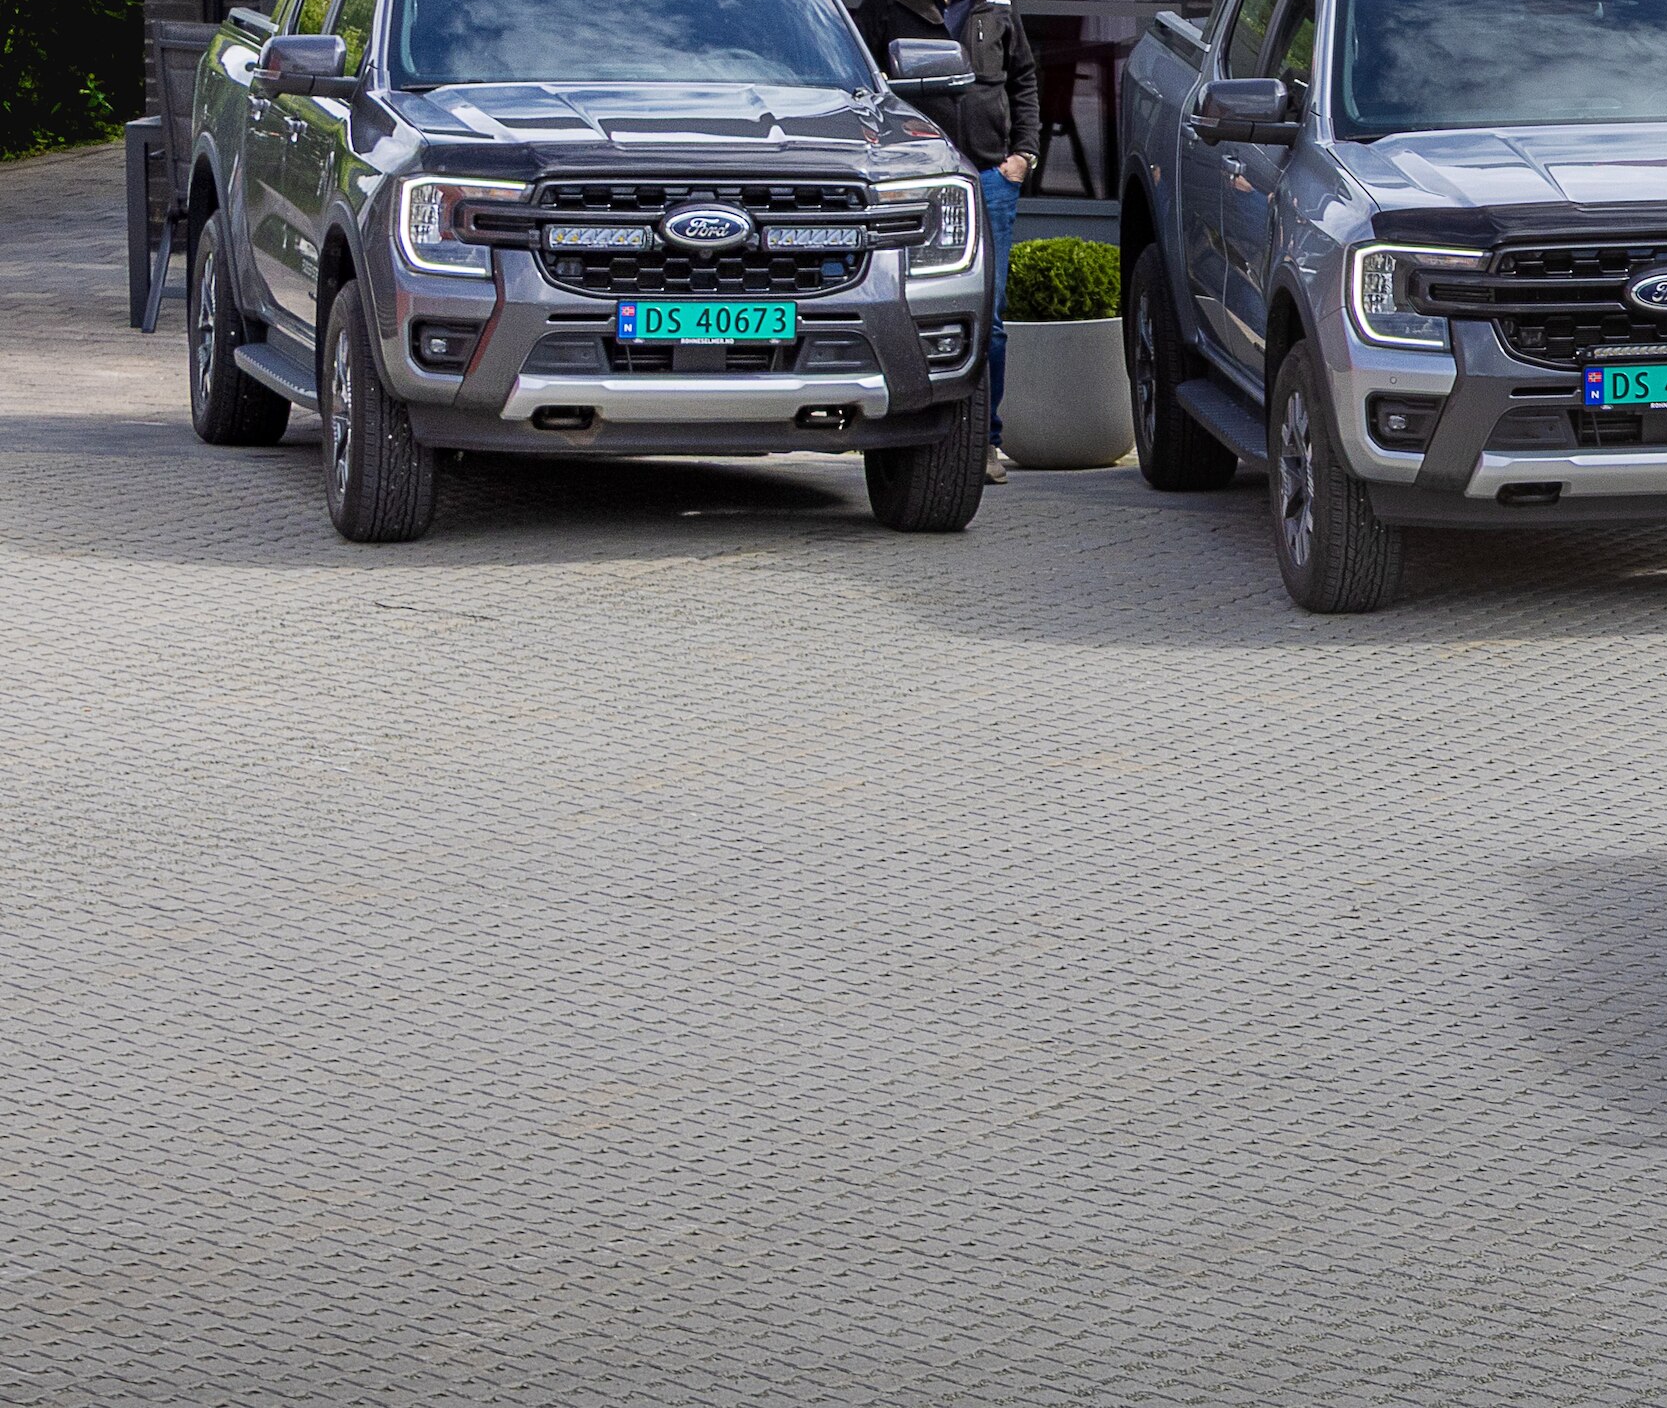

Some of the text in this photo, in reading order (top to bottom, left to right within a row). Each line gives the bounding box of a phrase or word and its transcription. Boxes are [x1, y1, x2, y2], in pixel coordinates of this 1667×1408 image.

[685, 217, 730, 237] Ford
[623, 323, 633, 333] N
[645, 306, 787, 334] DS 40673
[1591, 390, 1600, 399] N
[1612, 371, 1650, 400] DS
